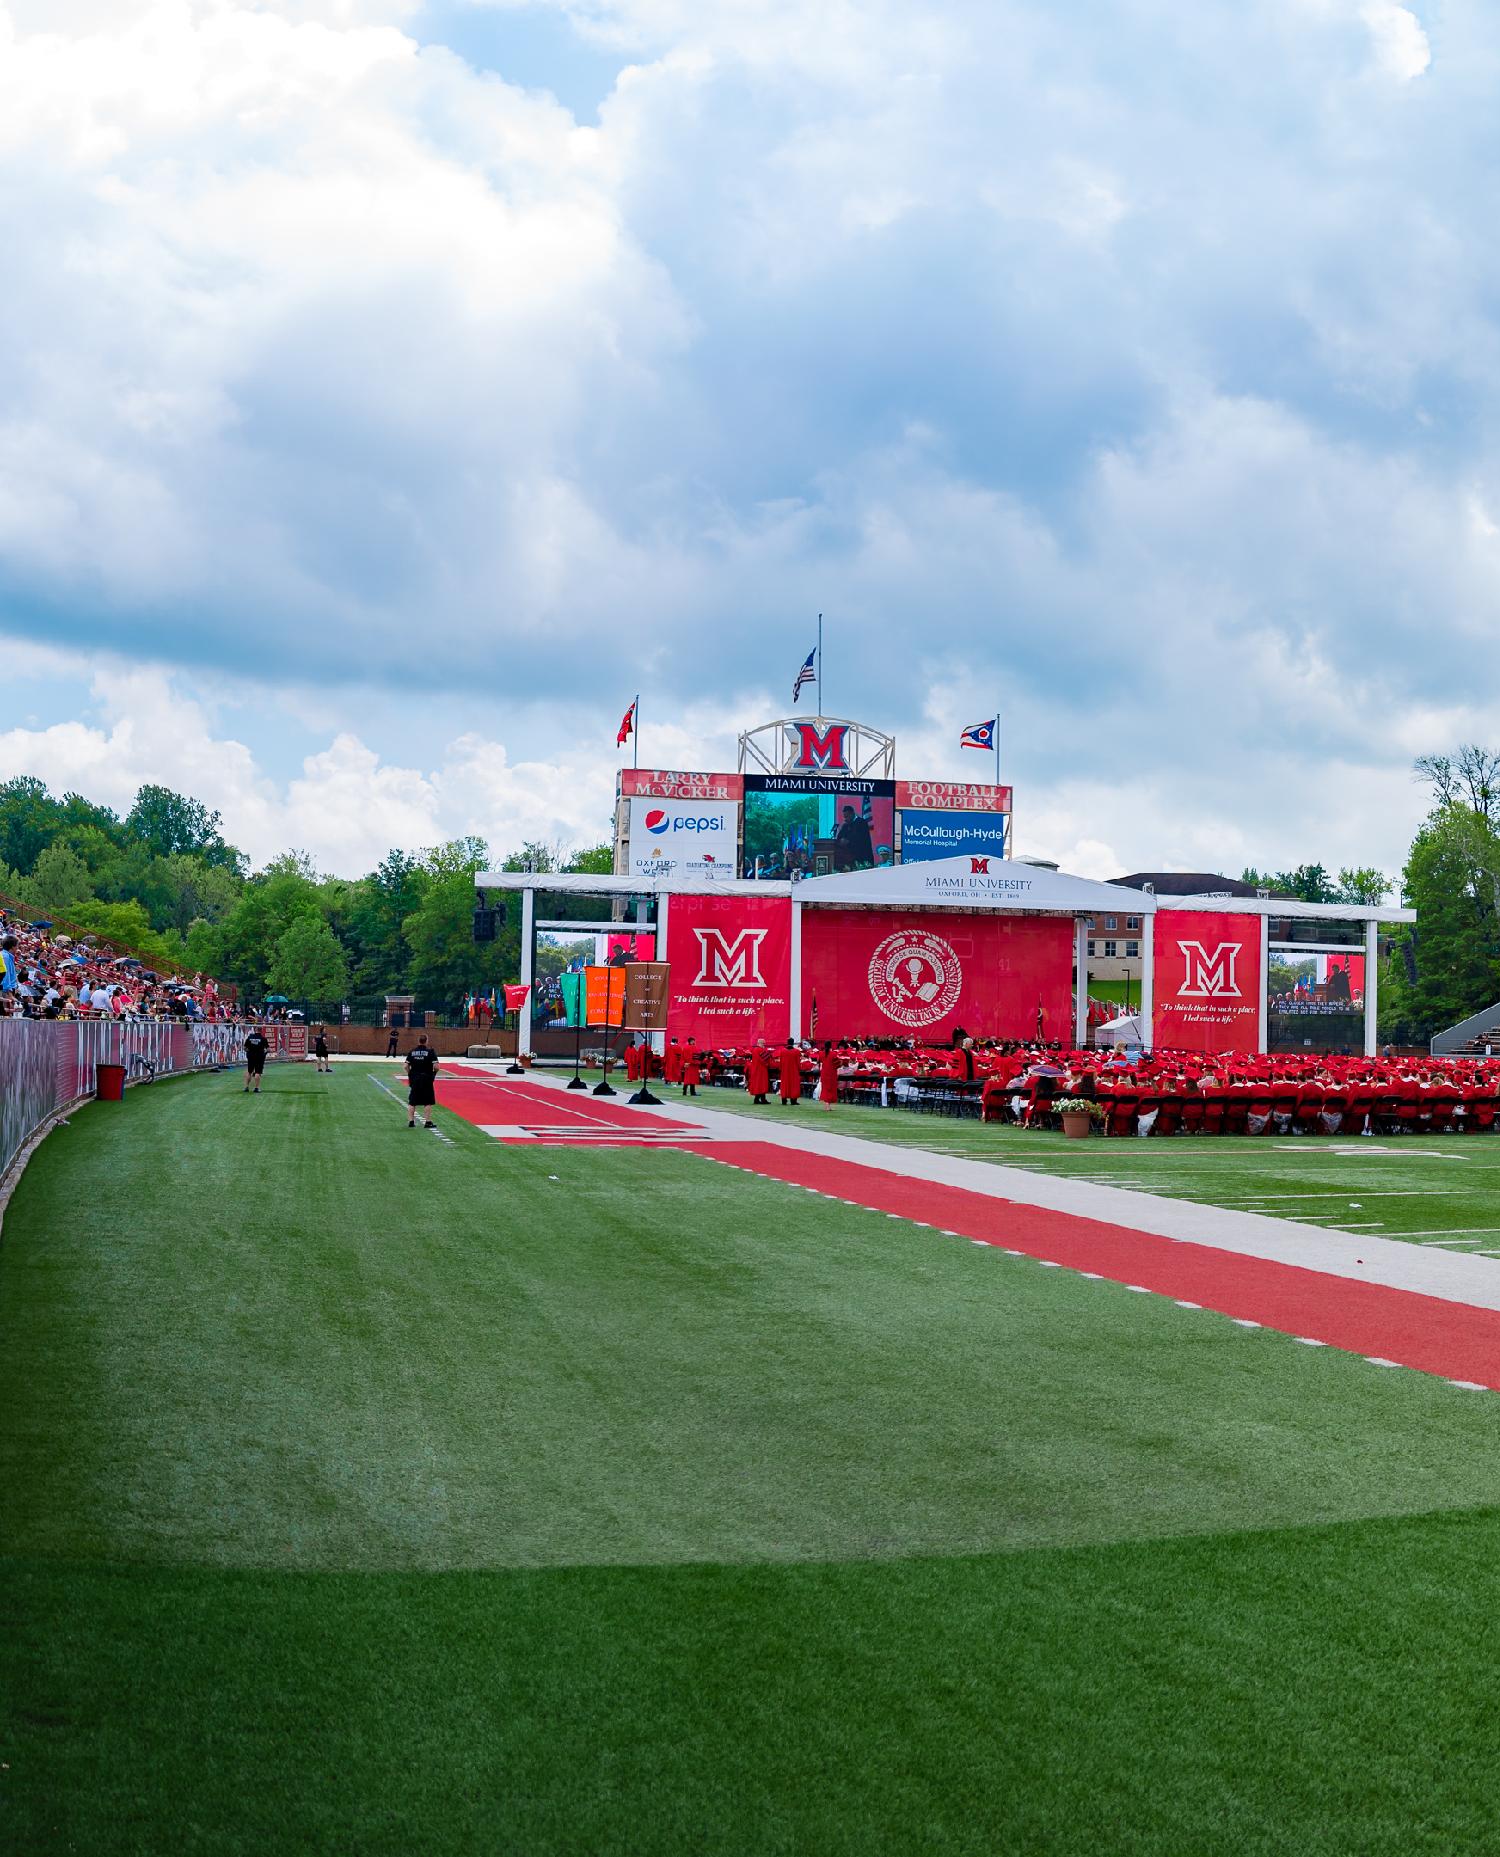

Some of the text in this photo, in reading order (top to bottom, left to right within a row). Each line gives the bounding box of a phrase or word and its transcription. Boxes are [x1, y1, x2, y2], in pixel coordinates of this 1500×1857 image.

[792, 722, 850, 770] M
[652, 771, 713, 786] LARRY
[765, 778, 875, 792] MIAMI UNIVERSITY
[636, 783, 730, 800] McVICKER
[907, 782, 1000, 798] FOOTBALL
[910, 794, 998, 810] COMPLEX
[674, 816, 724, 833] pepsi
[970, 858, 990, 874] M
[925, 878, 1032, 890] MIAMI UNIVERSITY
[692, 928, 768, 988] M
[1176, 940, 1242, 996] M
